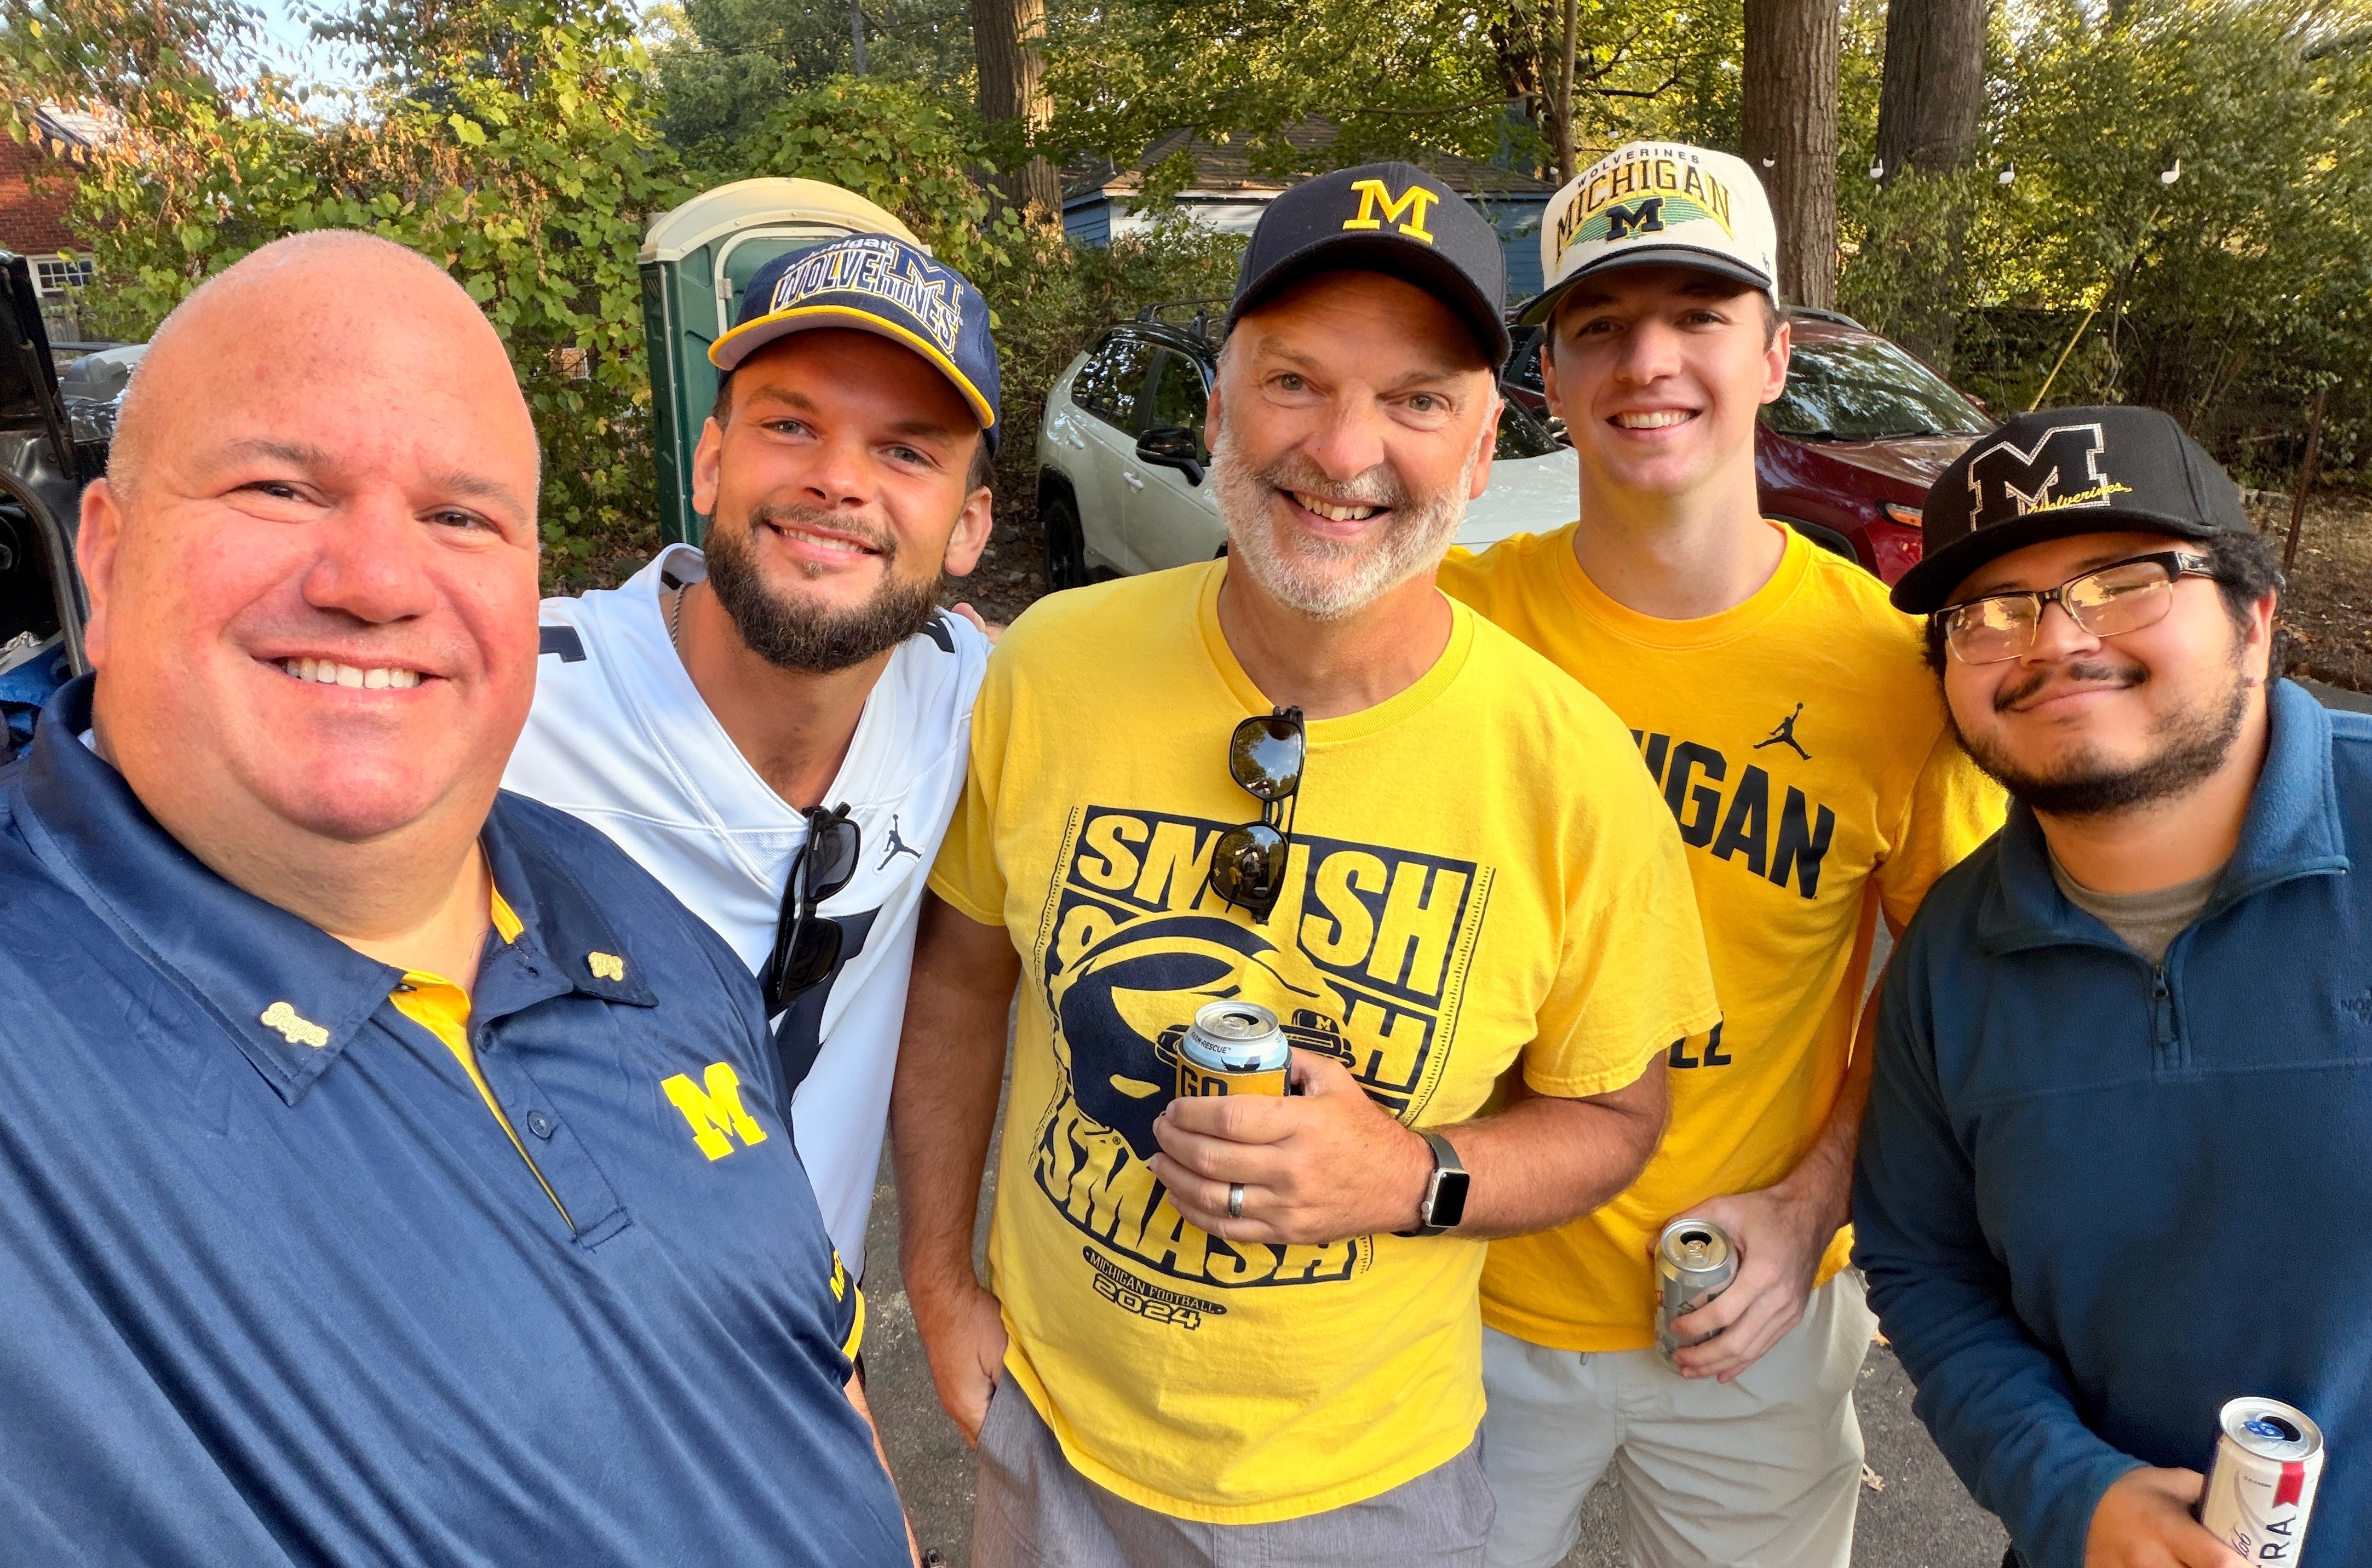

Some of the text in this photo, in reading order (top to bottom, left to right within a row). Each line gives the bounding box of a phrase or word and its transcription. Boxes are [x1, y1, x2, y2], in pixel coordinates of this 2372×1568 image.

[1577, 147, 1700, 188] WOLVERINES
[1342, 179, 1439, 245] M
[1556, 159, 1735, 273] MICHIGAN
[1605, 197, 1665, 242] M
[883, 240, 964, 315] M
[1968, 422, 2111, 532] M
[263, 1002, 328, 1047] Papa
[1315, 1015, 1332, 1031] M
[662, 1061, 767, 1161] M
[1037, 1094, 1352, 1284] SMA
[1090, 1251, 1215, 1313] MICHIGAN FOOTBALL
[1092, 1272, 1202, 1330] 2024
